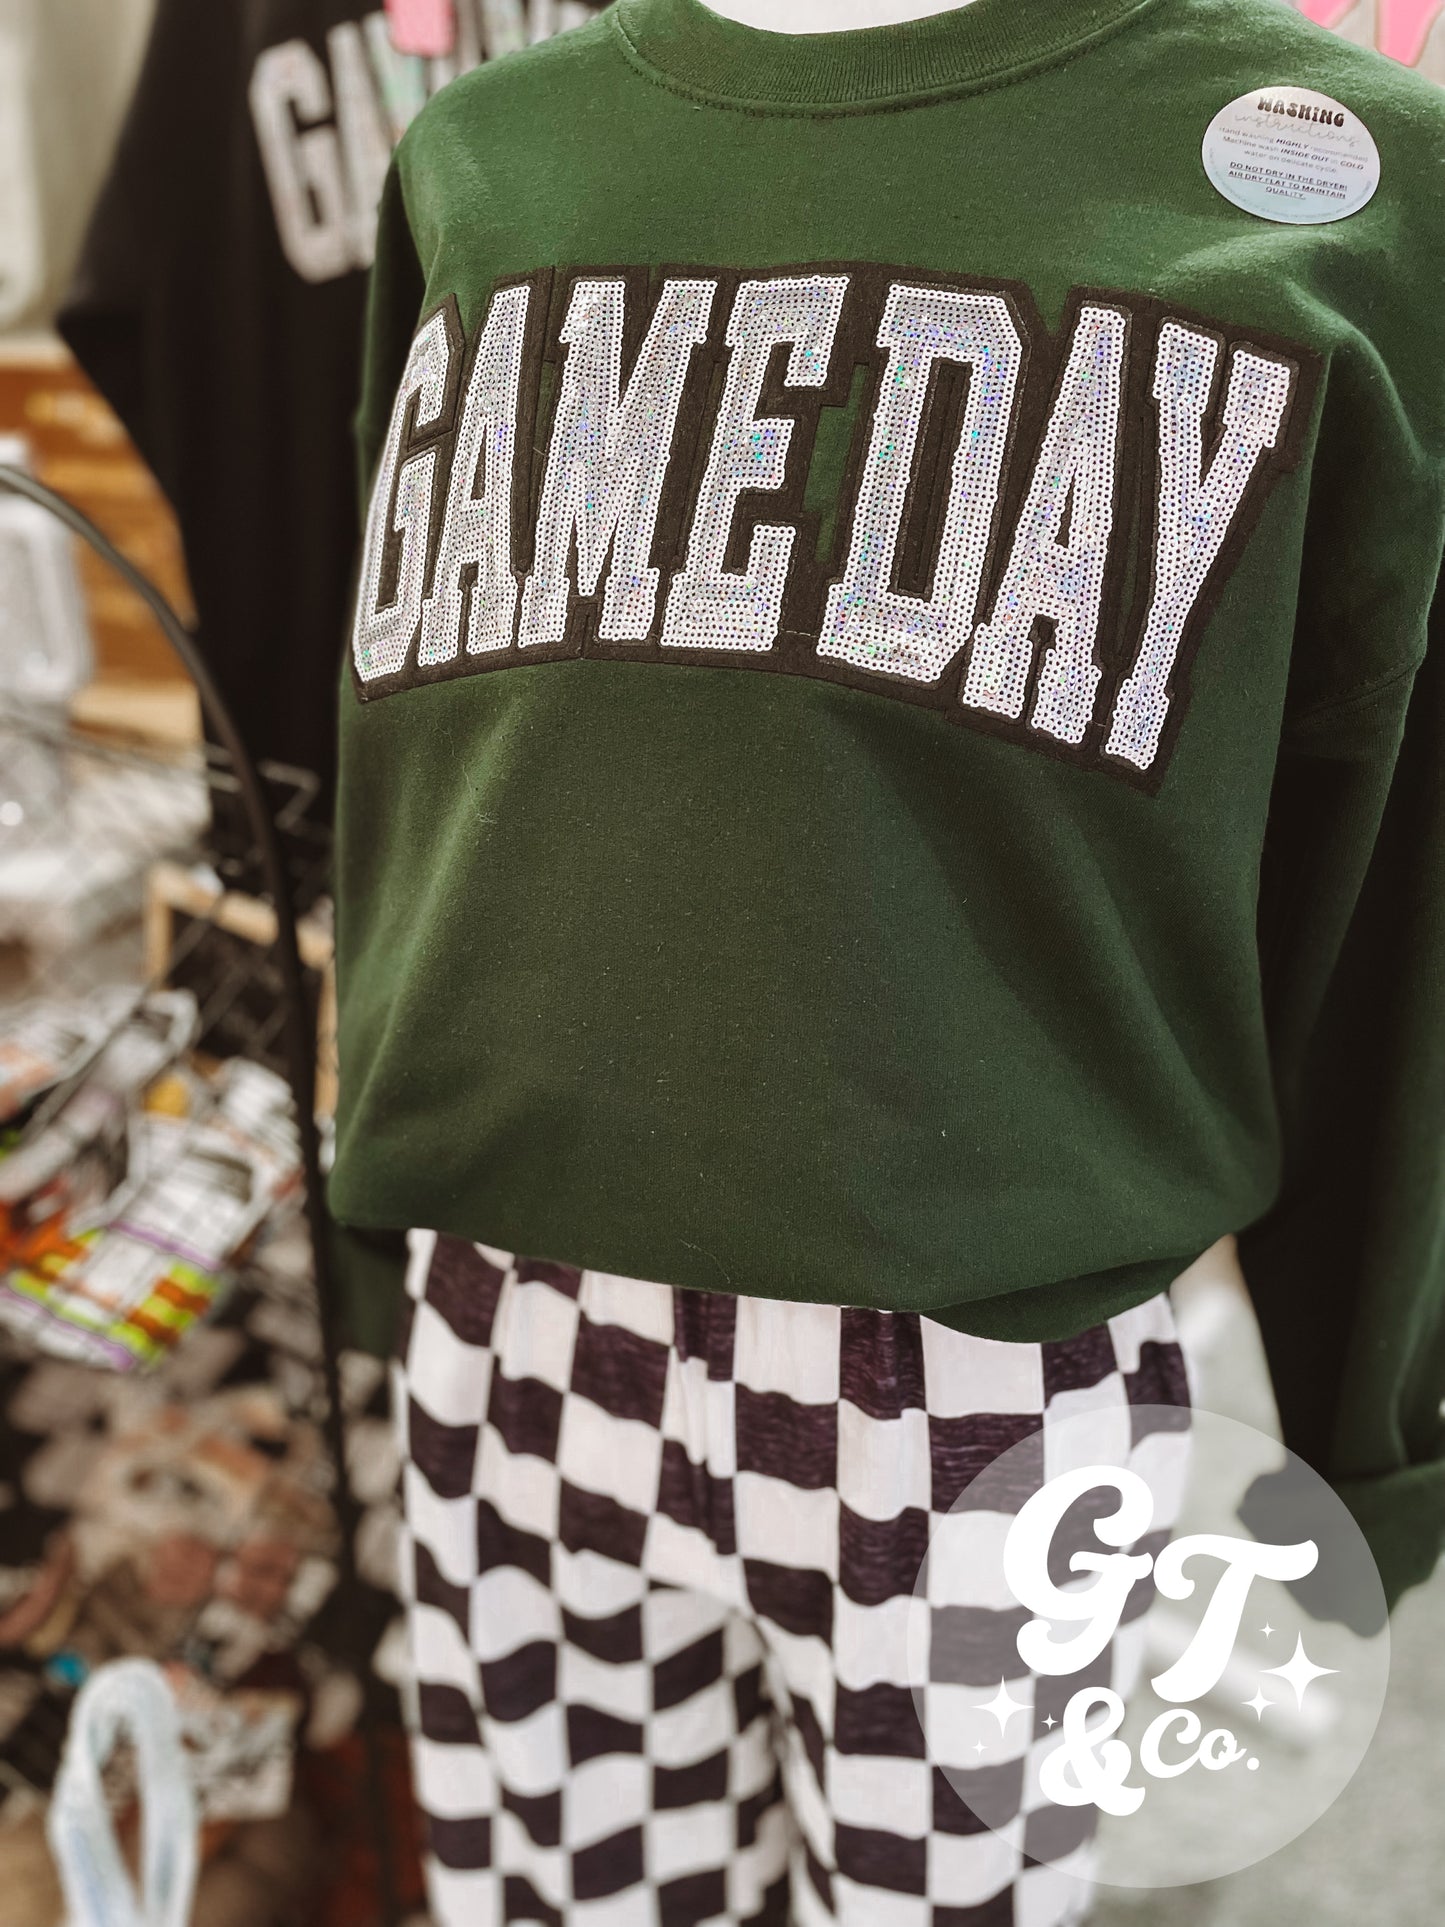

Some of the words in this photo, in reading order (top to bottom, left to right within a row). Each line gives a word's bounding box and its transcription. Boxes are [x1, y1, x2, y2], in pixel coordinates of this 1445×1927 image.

[1235, 113, 1360, 147] instructions
[1242, 132, 1274, 144] washing
[1276, 138, 1309, 150] HIGHLY
[1223, 135, 1257, 148] Machine
[1258, 143, 1279, 152] wash
[1280, 148, 1310, 159] INSIDE
[1310, 153, 1329, 163] OUT
[1340, 160, 1364, 170] COLD
[1244, 150, 1267, 159] water
[1281, 157, 1314, 168] delicate
[1228, 170, 1243, 178] AIR
[1244, 173, 1264, 182] DRY
[1265, 177, 1286, 187] FLAT
[1288, 182, 1300, 190] TO
[1301, 185, 1346, 199] MAINTAIN
[1229, 161, 1243, 169] DO
[1245, 165, 1264, 173] NOT
[1265, 168, 1284, 177] DRY
[1285, 172, 1295, 180] IN
[1297, 175, 1314, 184] THE
[350, 274, 851, 683] GAME
[815, 282, 1293, 770] DAY
